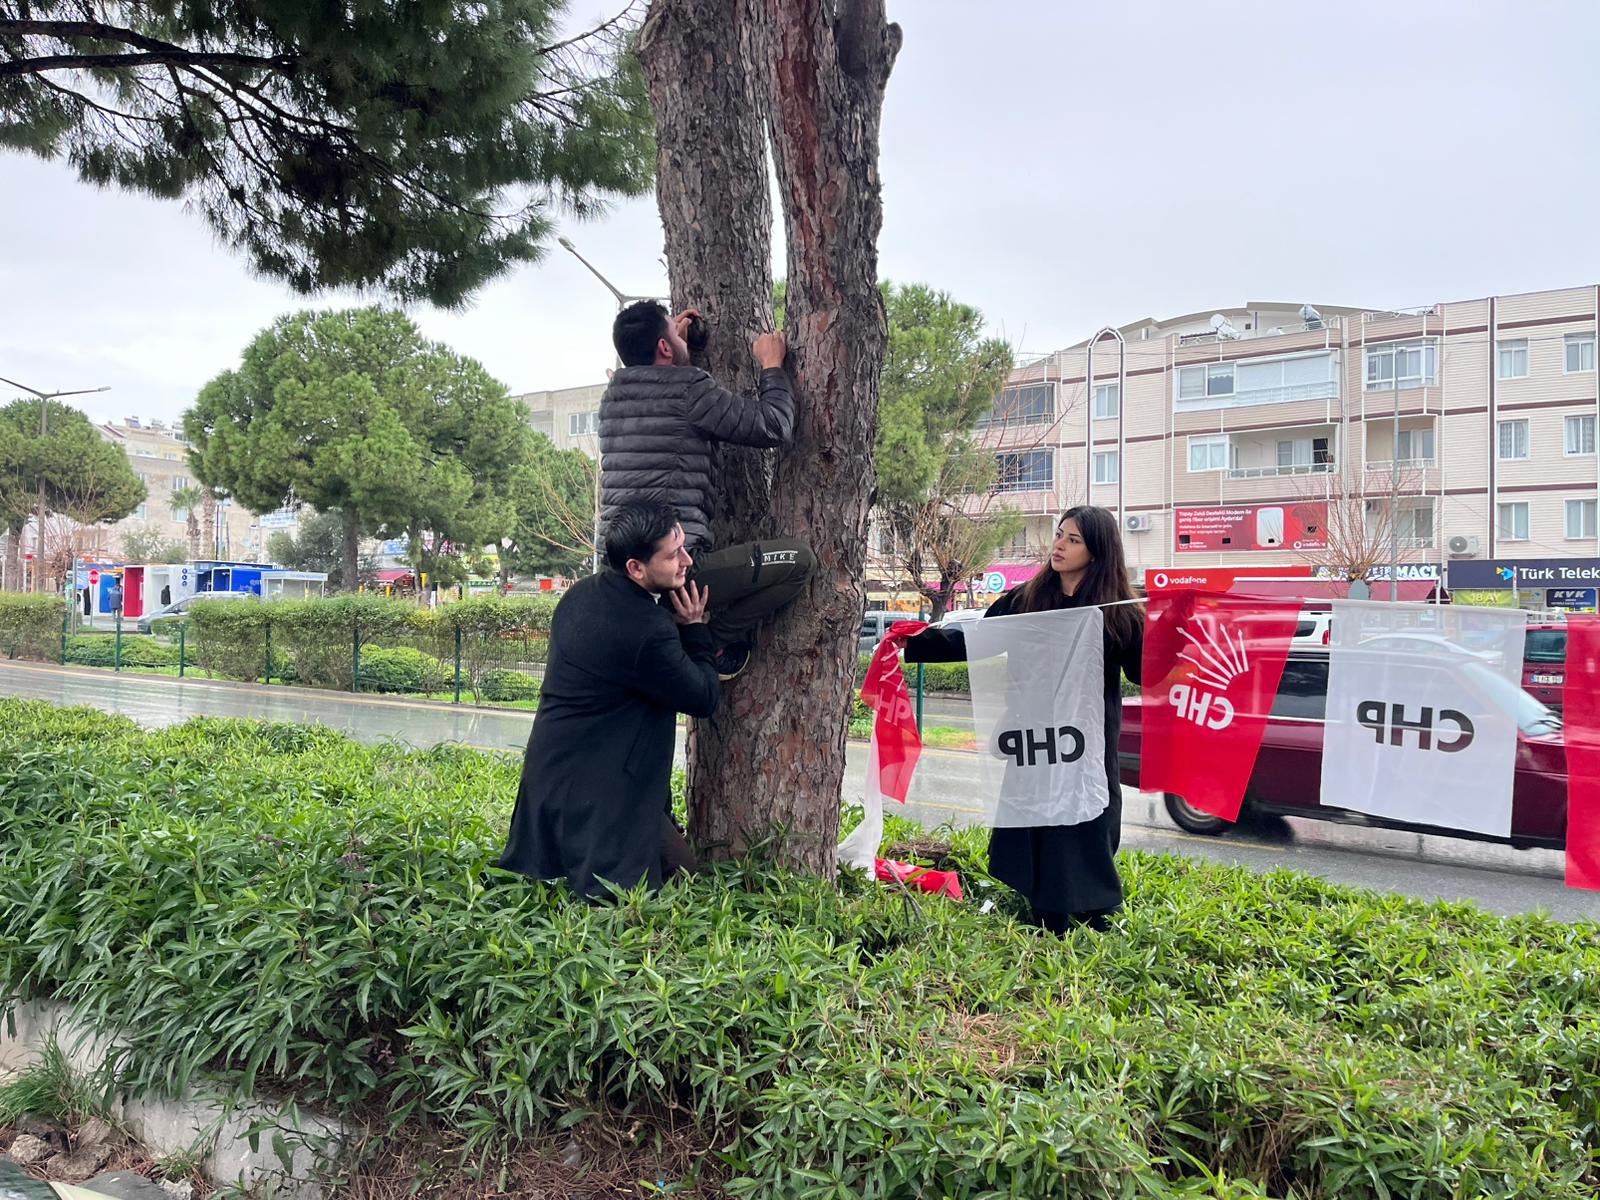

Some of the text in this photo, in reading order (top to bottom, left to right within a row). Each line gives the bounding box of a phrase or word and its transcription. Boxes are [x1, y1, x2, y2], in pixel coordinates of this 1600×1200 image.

[764, 553, 796, 562] NIKE
[1520, 567, 1600, 580] Türk Telek
[1169, 576, 1207, 584] vodafone
[1472, 593, 1483, 602] 18
[1554, 590, 1587, 598] KVK
[875, 687, 912, 726] HP
